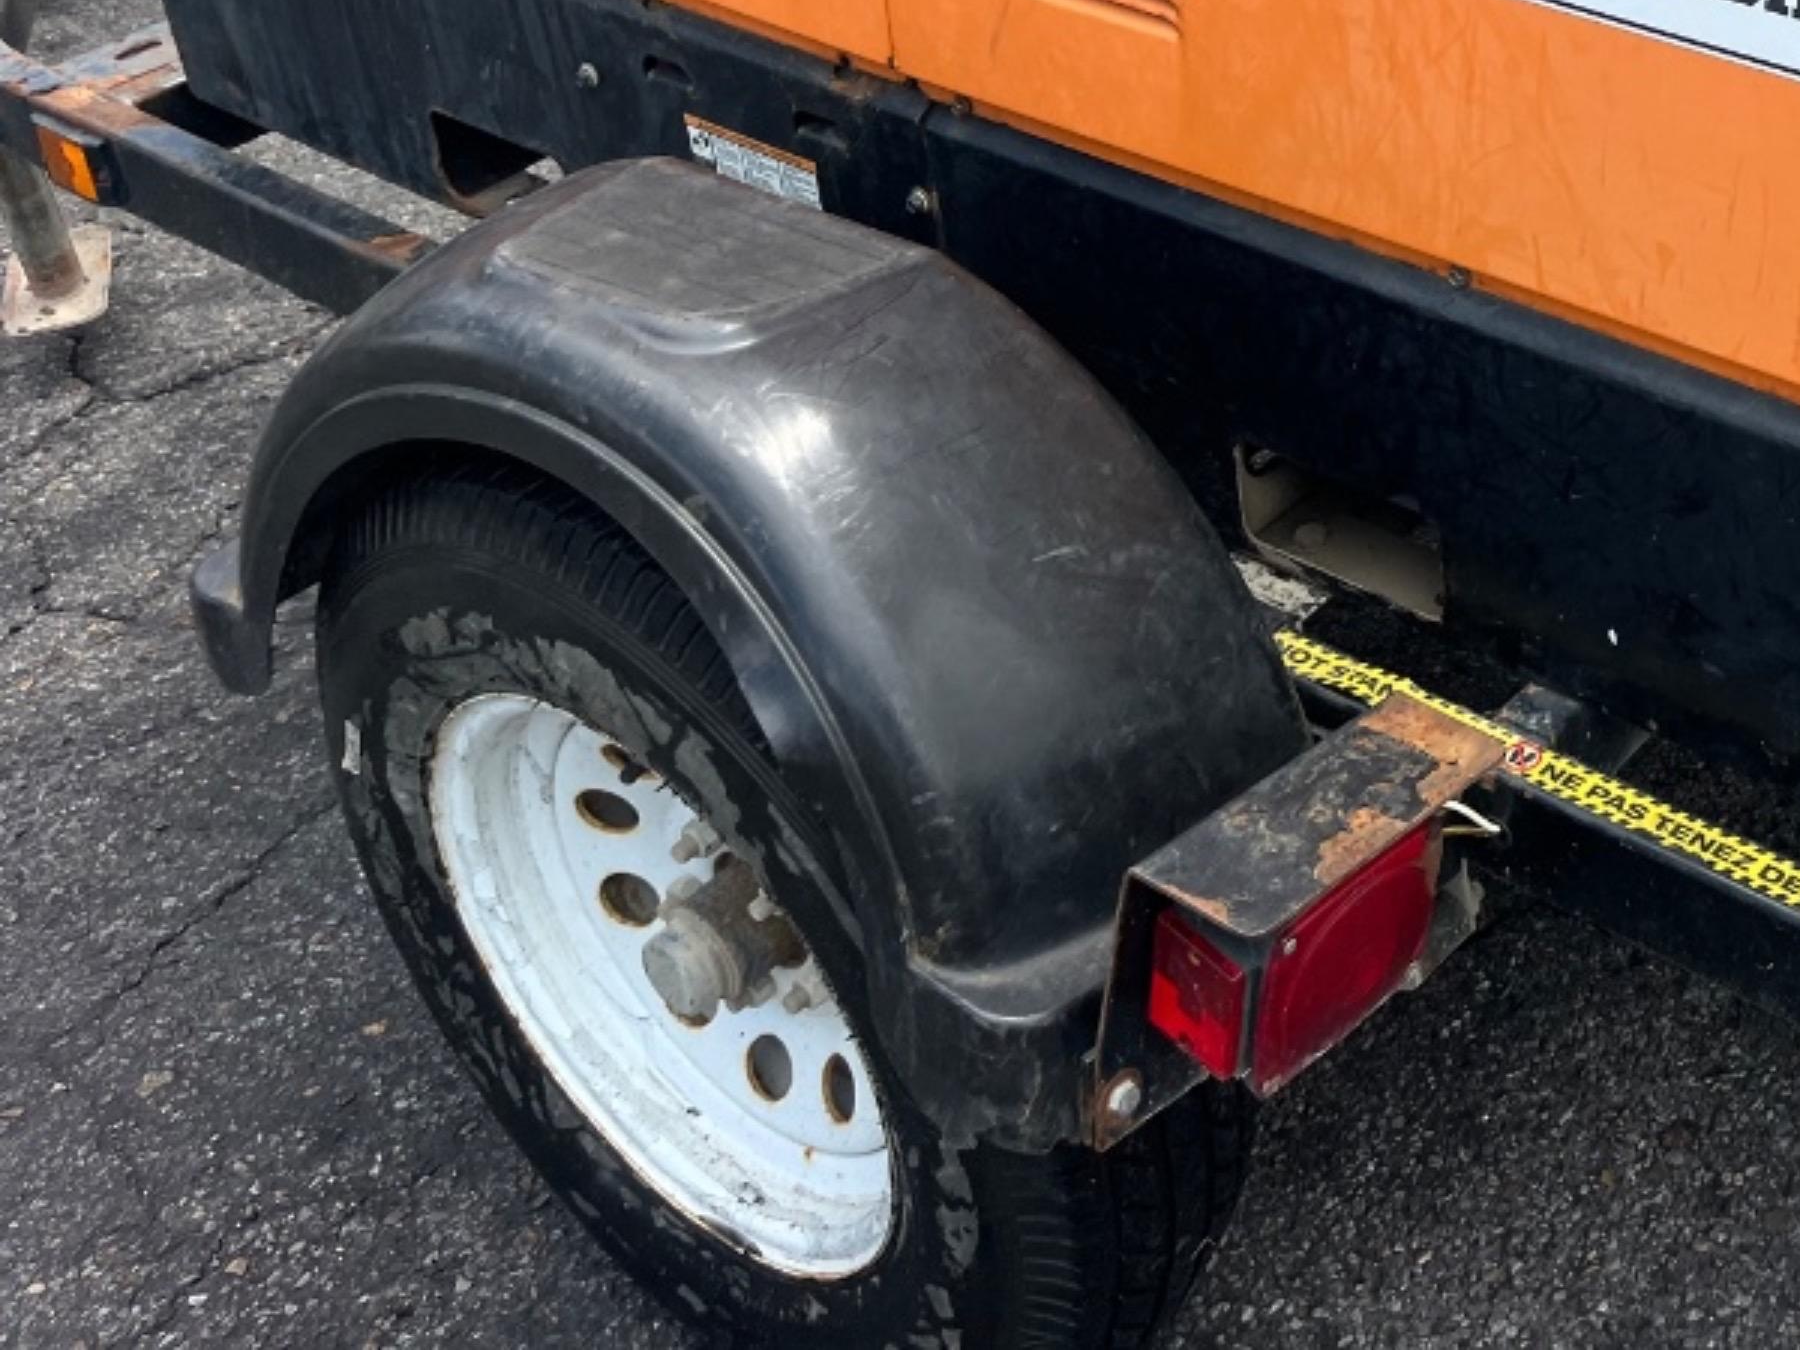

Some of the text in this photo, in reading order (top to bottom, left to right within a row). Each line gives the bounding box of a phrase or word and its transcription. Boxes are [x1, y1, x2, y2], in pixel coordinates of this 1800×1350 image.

[1287, 645, 1331, 669] OT
[1538, 762, 1587, 792] NE
[1586, 784, 1650, 820] PAS
[1654, 812, 1758, 872] TENEZ
